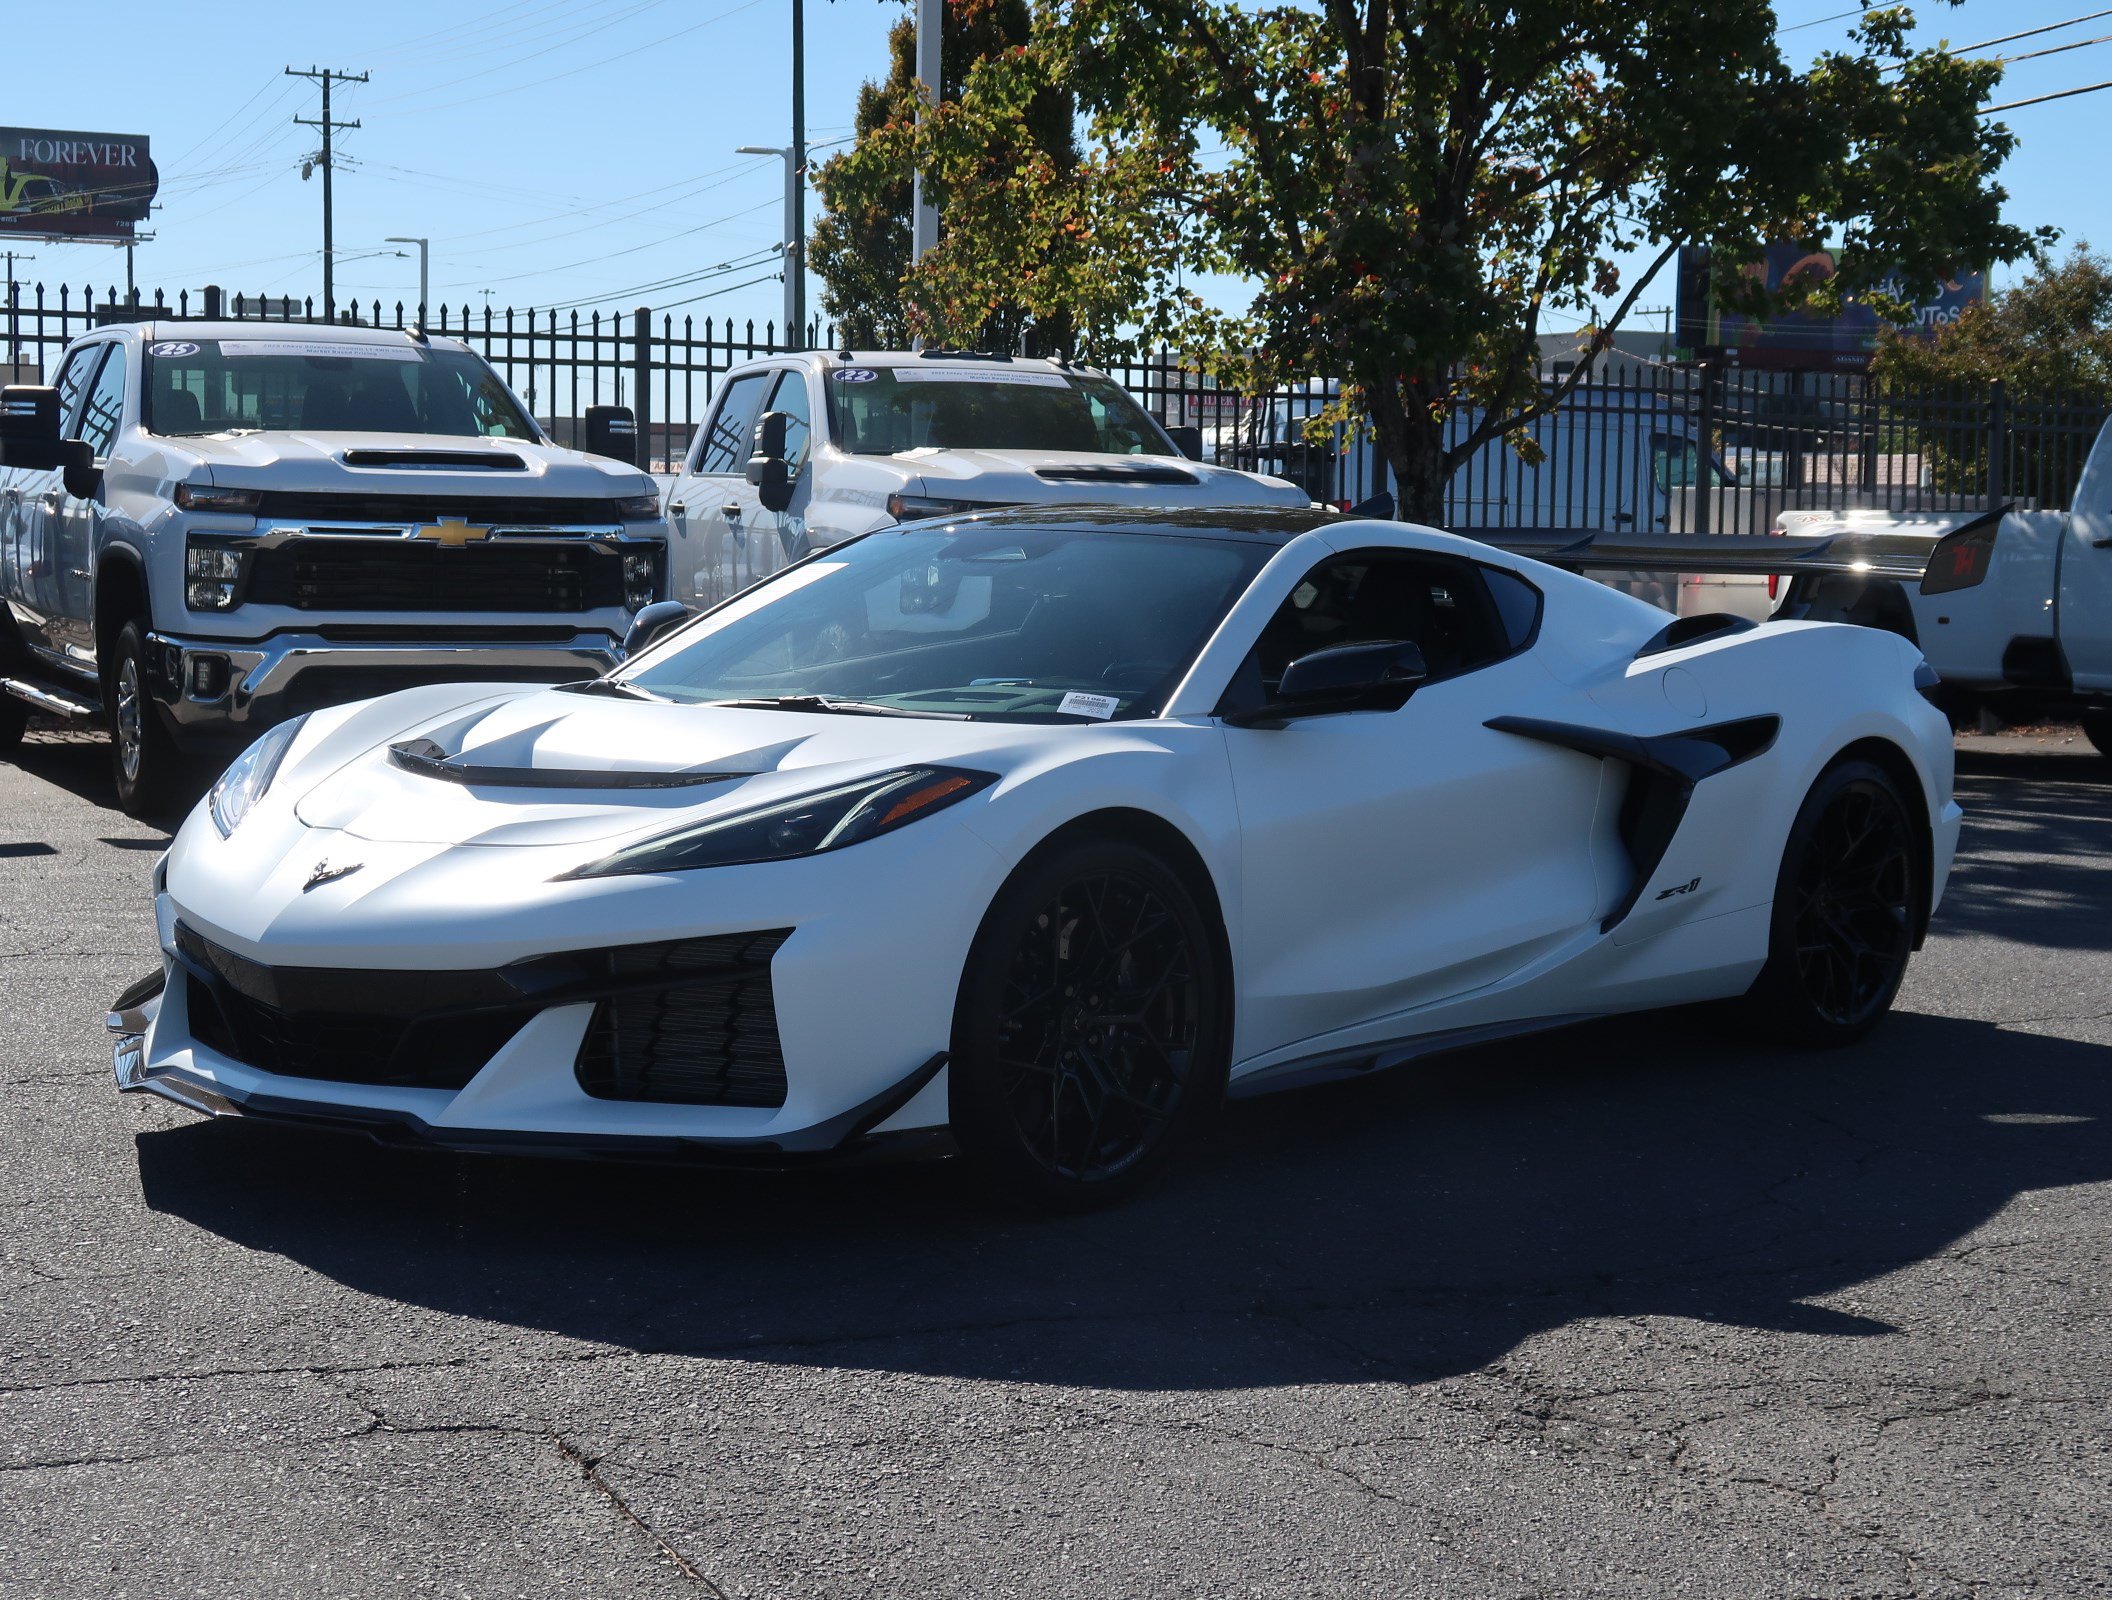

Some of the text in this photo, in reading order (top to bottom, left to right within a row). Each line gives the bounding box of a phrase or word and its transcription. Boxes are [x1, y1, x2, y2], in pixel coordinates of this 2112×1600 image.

[20, 138, 136, 167] FOREVER
[159, 343, 190, 355] 25
[840, 370, 870, 381] 22
[1655, 876, 1702, 901] ZR1
